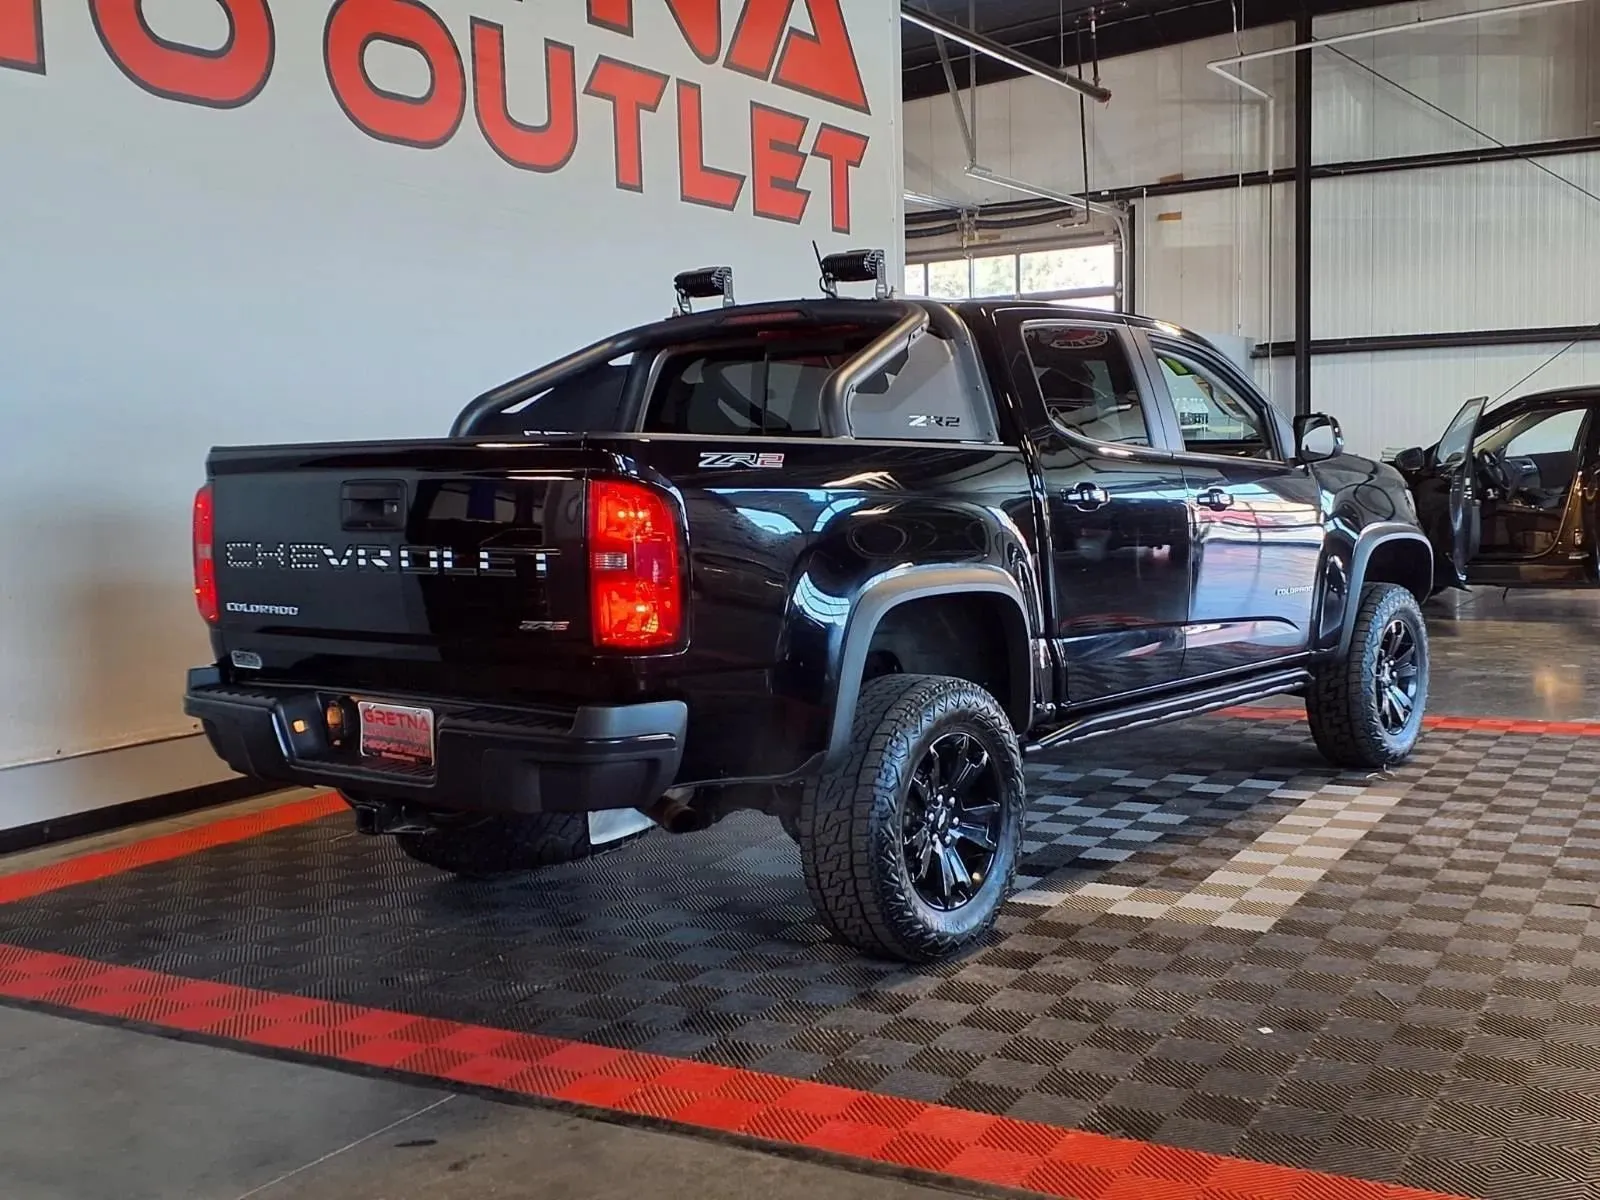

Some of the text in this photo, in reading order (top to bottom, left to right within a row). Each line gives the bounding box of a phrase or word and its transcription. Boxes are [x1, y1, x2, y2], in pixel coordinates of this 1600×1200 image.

[322, 0, 870, 235] OUTLET
[908, 415, 960, 427] ZR2
[698, 452, 785, 468] ZR2
[225, 541, 561, 578] CHEVROLET
[226, 602, 299, 616] COLORADO
[363, 709, 431, 732] GRETNA
